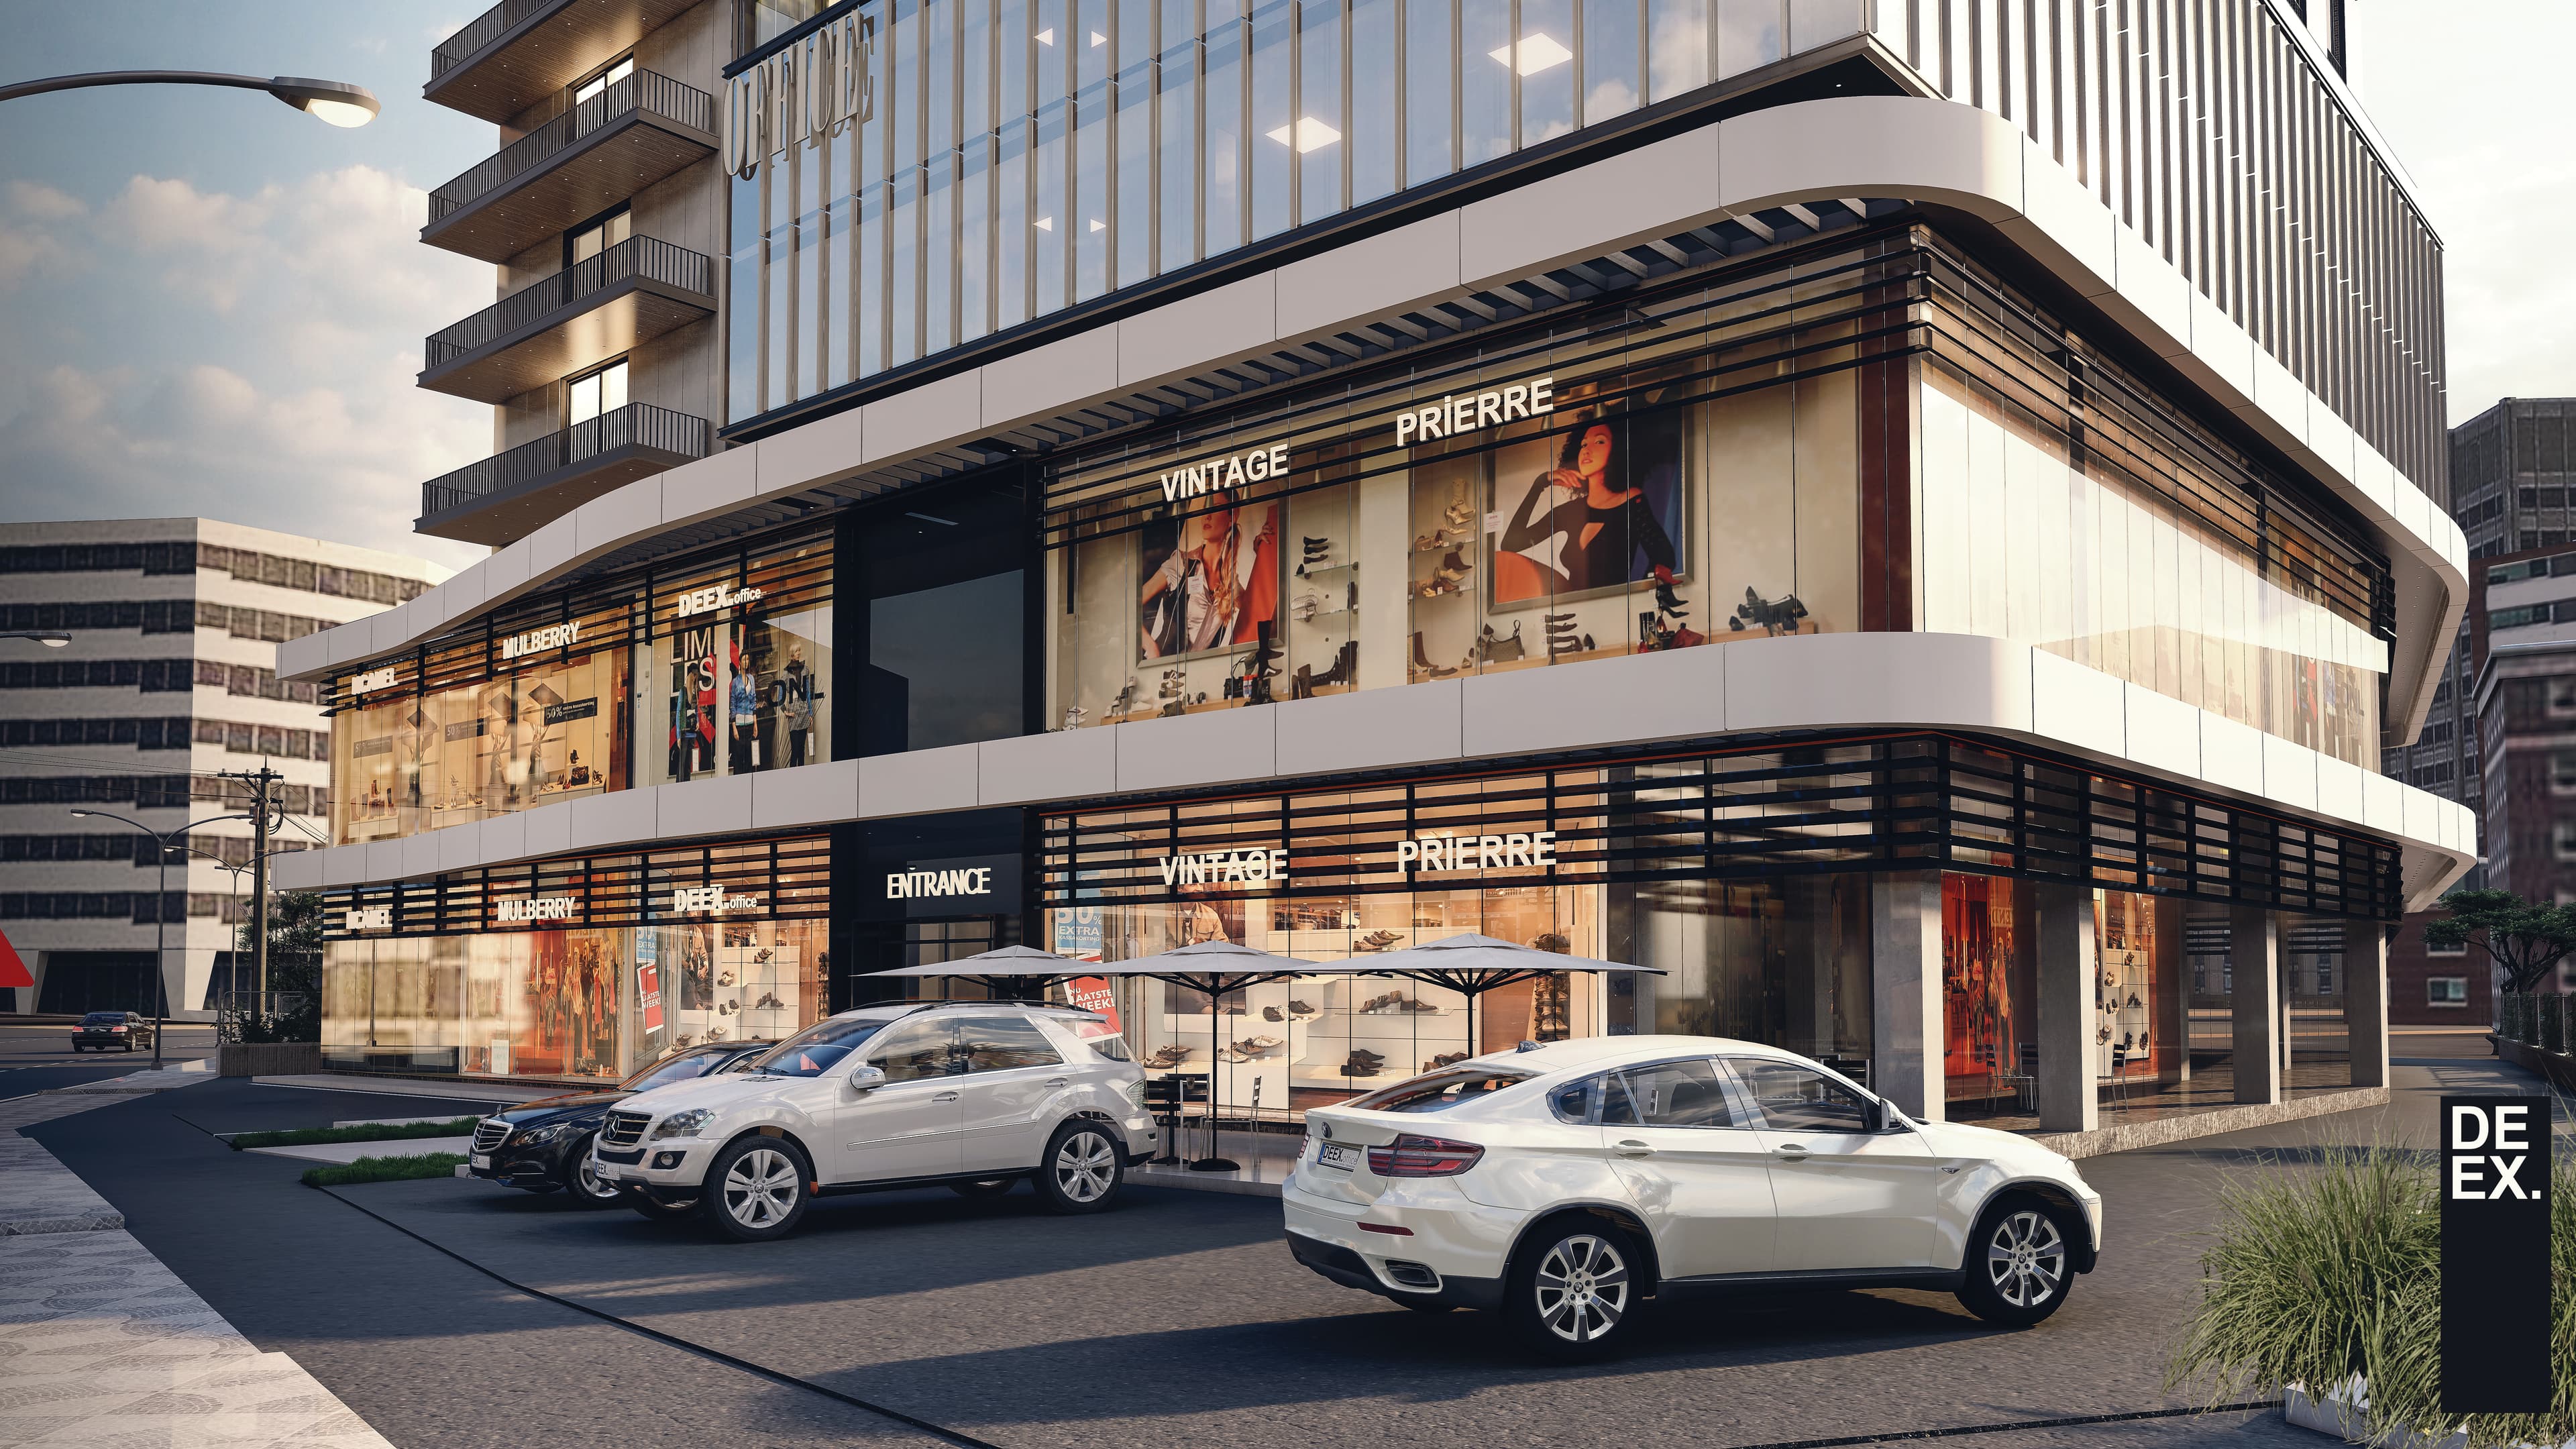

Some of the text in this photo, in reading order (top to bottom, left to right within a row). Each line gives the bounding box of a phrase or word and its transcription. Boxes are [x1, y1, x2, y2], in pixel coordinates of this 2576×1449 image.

[722, 9, 859, 176] OFFICE
[1161, 444, 1288, 502] VINTAGE
[503, 621, 580, 659] MULBERRY
[888, 867, 991, 899] ENTRANCE
[1159, 849, 1288, 885] VINTAGE
[498, 897, 576, 921] MULBERRY
[1059, 926, 1100, 936] EXTRA
